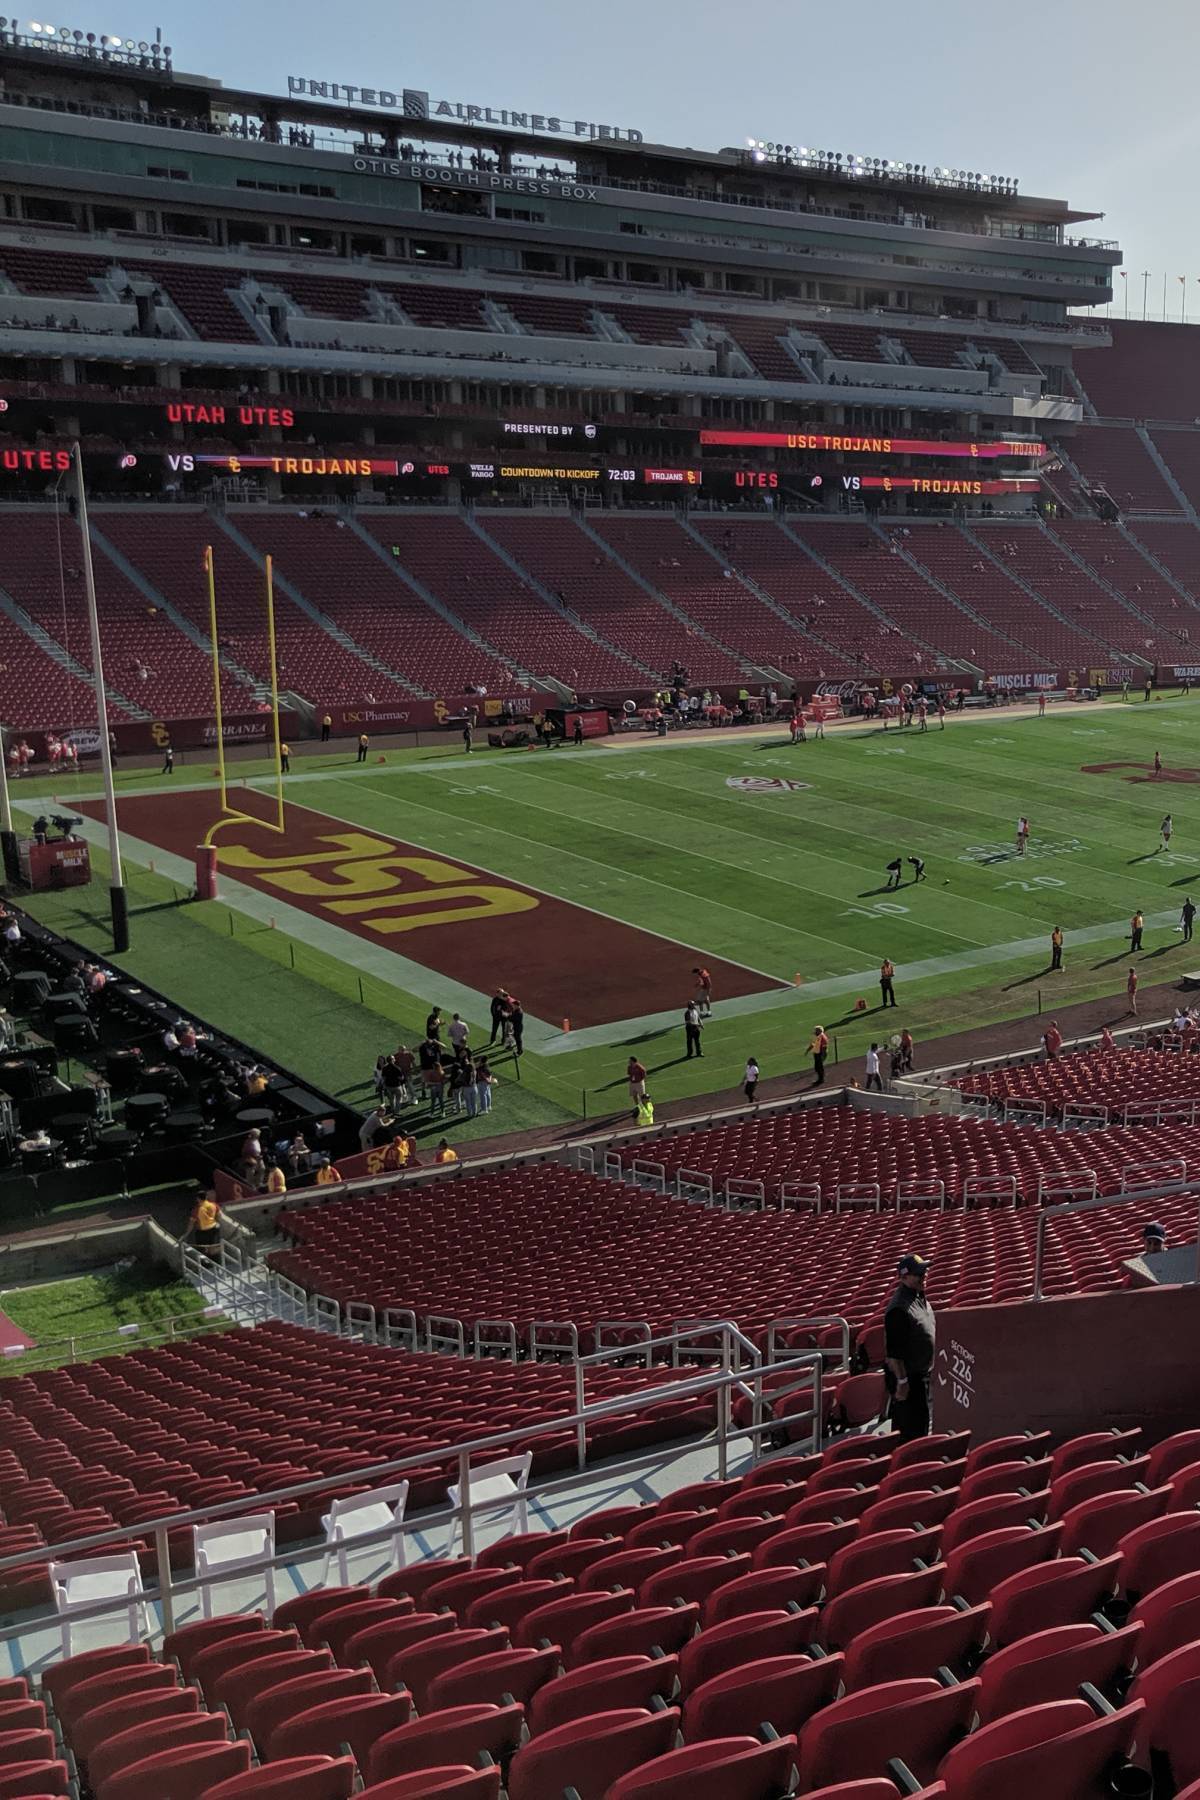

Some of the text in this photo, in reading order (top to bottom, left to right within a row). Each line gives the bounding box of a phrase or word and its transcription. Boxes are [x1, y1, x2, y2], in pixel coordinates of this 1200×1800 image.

[287, 75, 643, 144] UNITED AIRLINES FIELD
[353, 159, 597, 200] OTIS BOOTH PRESS BOX
[168, 404, 294, 427] UTAH UTES
[504, 424, 573, 435] PRESENTED BY
[787, 434, 891, 453] USC TROJANS
[1010, 444, 1042, 456] TROJANS
[4, 451, 71, 471] UTES
[168, 454, 195, 472] VS
[271, 457, 372, 475] TROJANS
[428, 465, 449, 475] UTES
[500, 467, 600, 479] COUNTDOWN TO KICKOFF
[608, 469, 636, 481] 72:03
[651, 472, 683, 481] TROJANS
[735, 472, 778, 488] UTES
[842, 476, 861, 490] VS
[912, 479, 982, 494] TROJANS
[365, 711, 410, 722] Pharmacy
[216, 832, 540, 934] USC
[951, 1339, 975, 1364] SECTIONS
[952, 1354, 972, 1383] 226
[952, 1381, 970, 1409] 126
